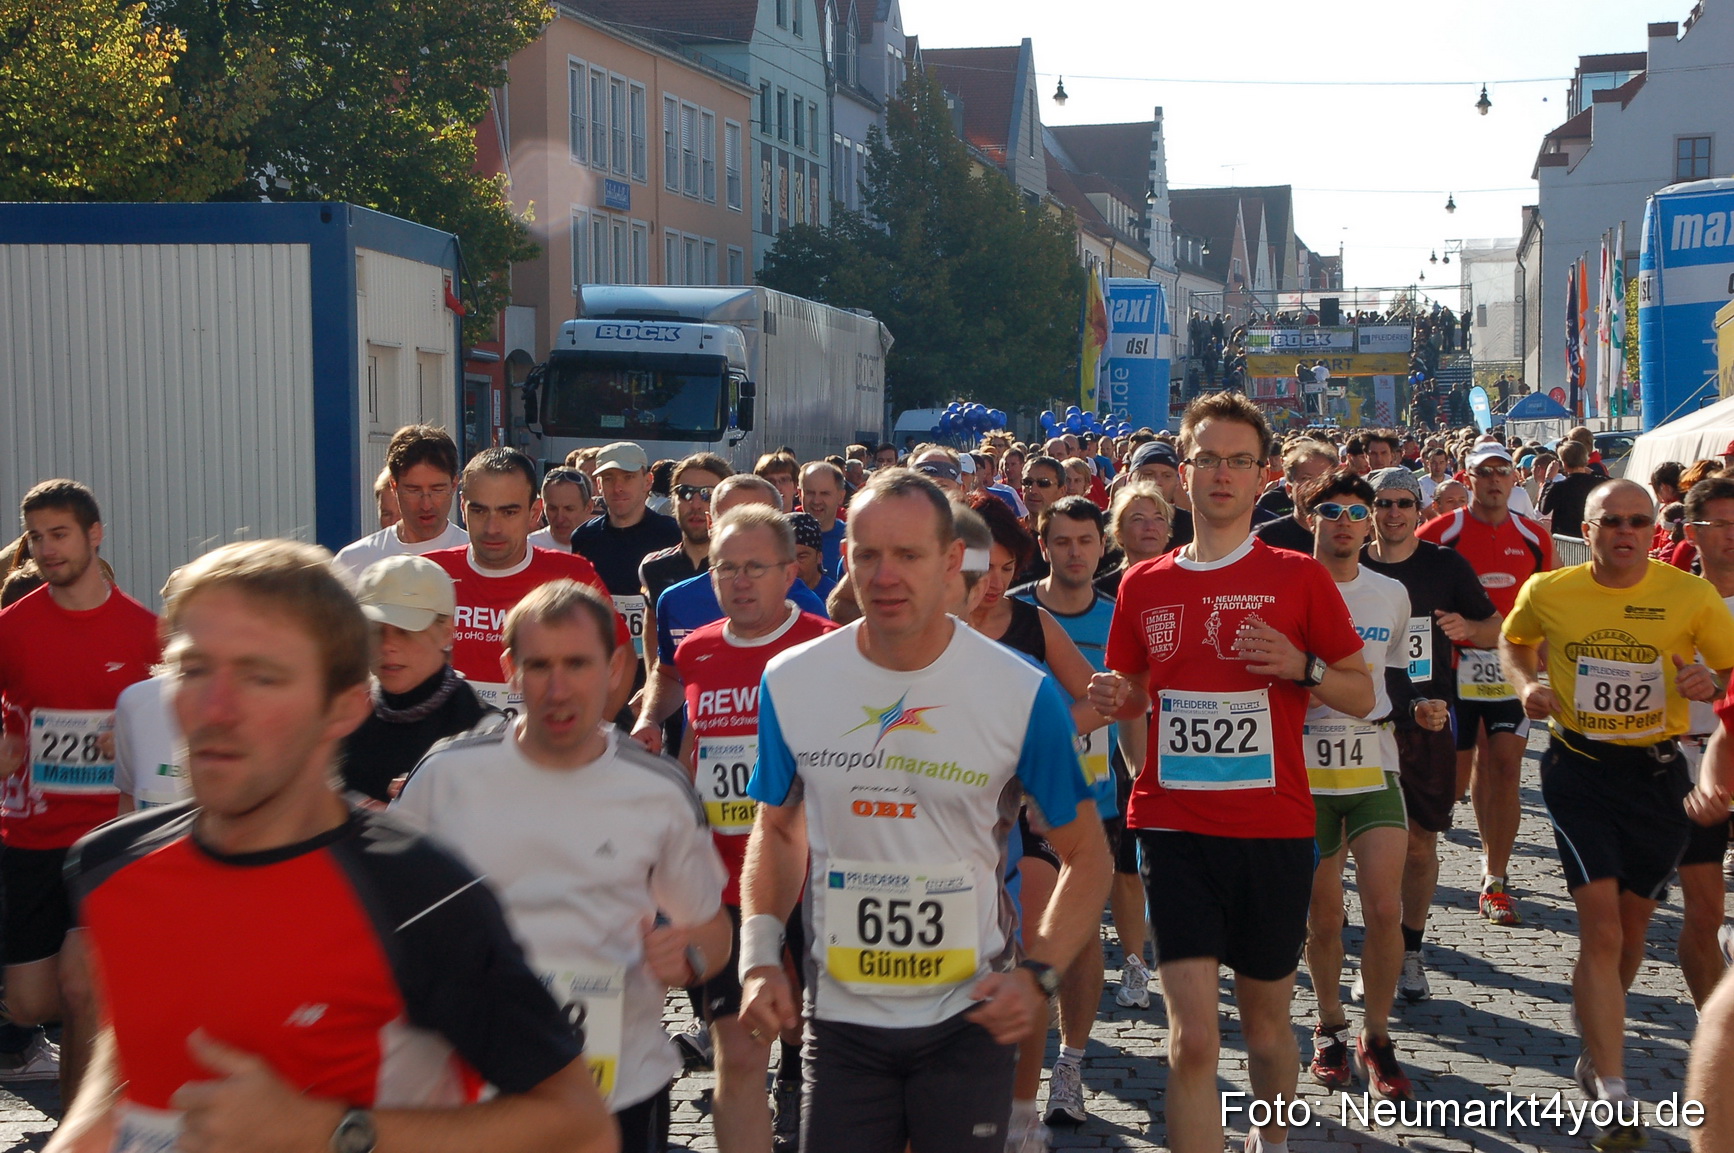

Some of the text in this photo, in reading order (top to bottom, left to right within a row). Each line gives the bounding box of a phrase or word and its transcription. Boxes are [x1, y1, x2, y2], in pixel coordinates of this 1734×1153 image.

[1111, 294, 1152, 322] axi
[596, 324, 681, 341] BOCK
[1271, 333, 1332, 347] BOCK
[1126, 337, 1149, 355] dsl
[1202, 594, 1276, 605] 11. NEUMARKTER
[1213, 602, 1263, 611] STADTLAUF
[1145, 621, 1176, 633] WIEDER
[1146, 612, 1175, 625] IMMER
[1148, 629, 1174, 646] NEU
[1172, 699, 1218, 710] PFLEIDERER
[1594, 681, 1651, 712] 882
[1230, 701, 1260, 711] BOCK
[1577, 710, 1664, 730] Hans-Peter
[1169, 716, 1259, 754] 3522
[1317, 738, 1364, 767] 914
[713, 763, 757, 799] 30
[852, 799, 918, 820] OBI
[858, 897, 944, 947] 653
[859, 949, 945, 979] Günter
